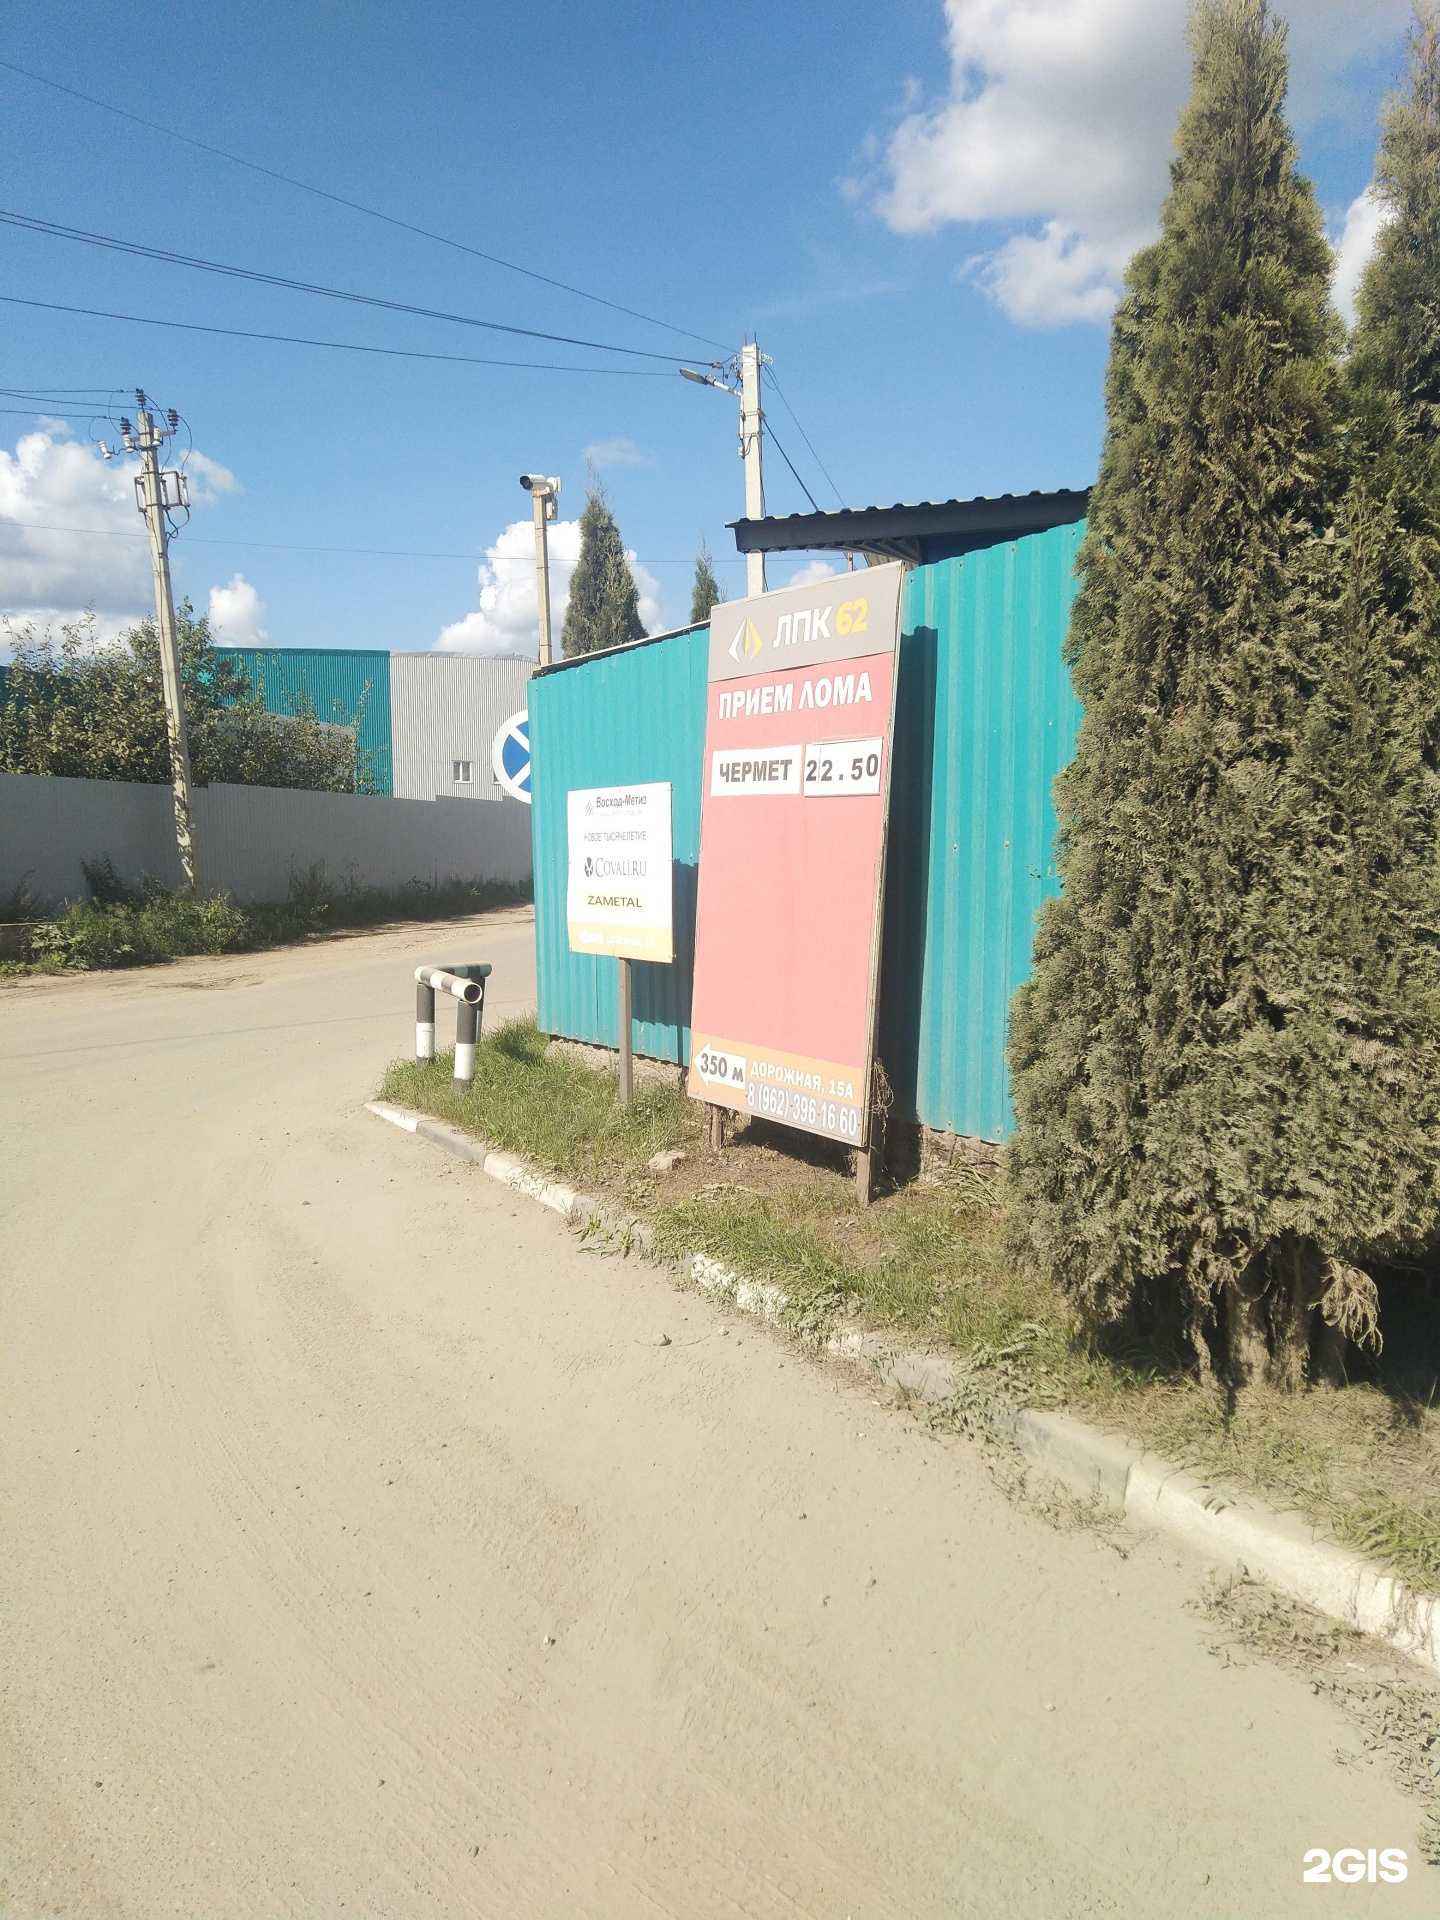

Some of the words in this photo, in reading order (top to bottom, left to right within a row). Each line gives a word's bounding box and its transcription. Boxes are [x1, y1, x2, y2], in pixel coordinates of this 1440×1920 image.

[772, 606, 833, 648] ЛПК
[835, 597, 871, 636] 62
[718, 682, 793, 720] ПРИЕМ
[798, 672, 873, 711] ЛОМА
[719, 760, 793, 783] ЧЕРМЕТ
[588, 896, 641, 908] ZAMETAL
[700, 1053, 727, 1078] 350
[747, 1083, 756, 1106] 8
[760, 1085, 790, 1119] (962)
[792, 1093, 817, 1124] 396
